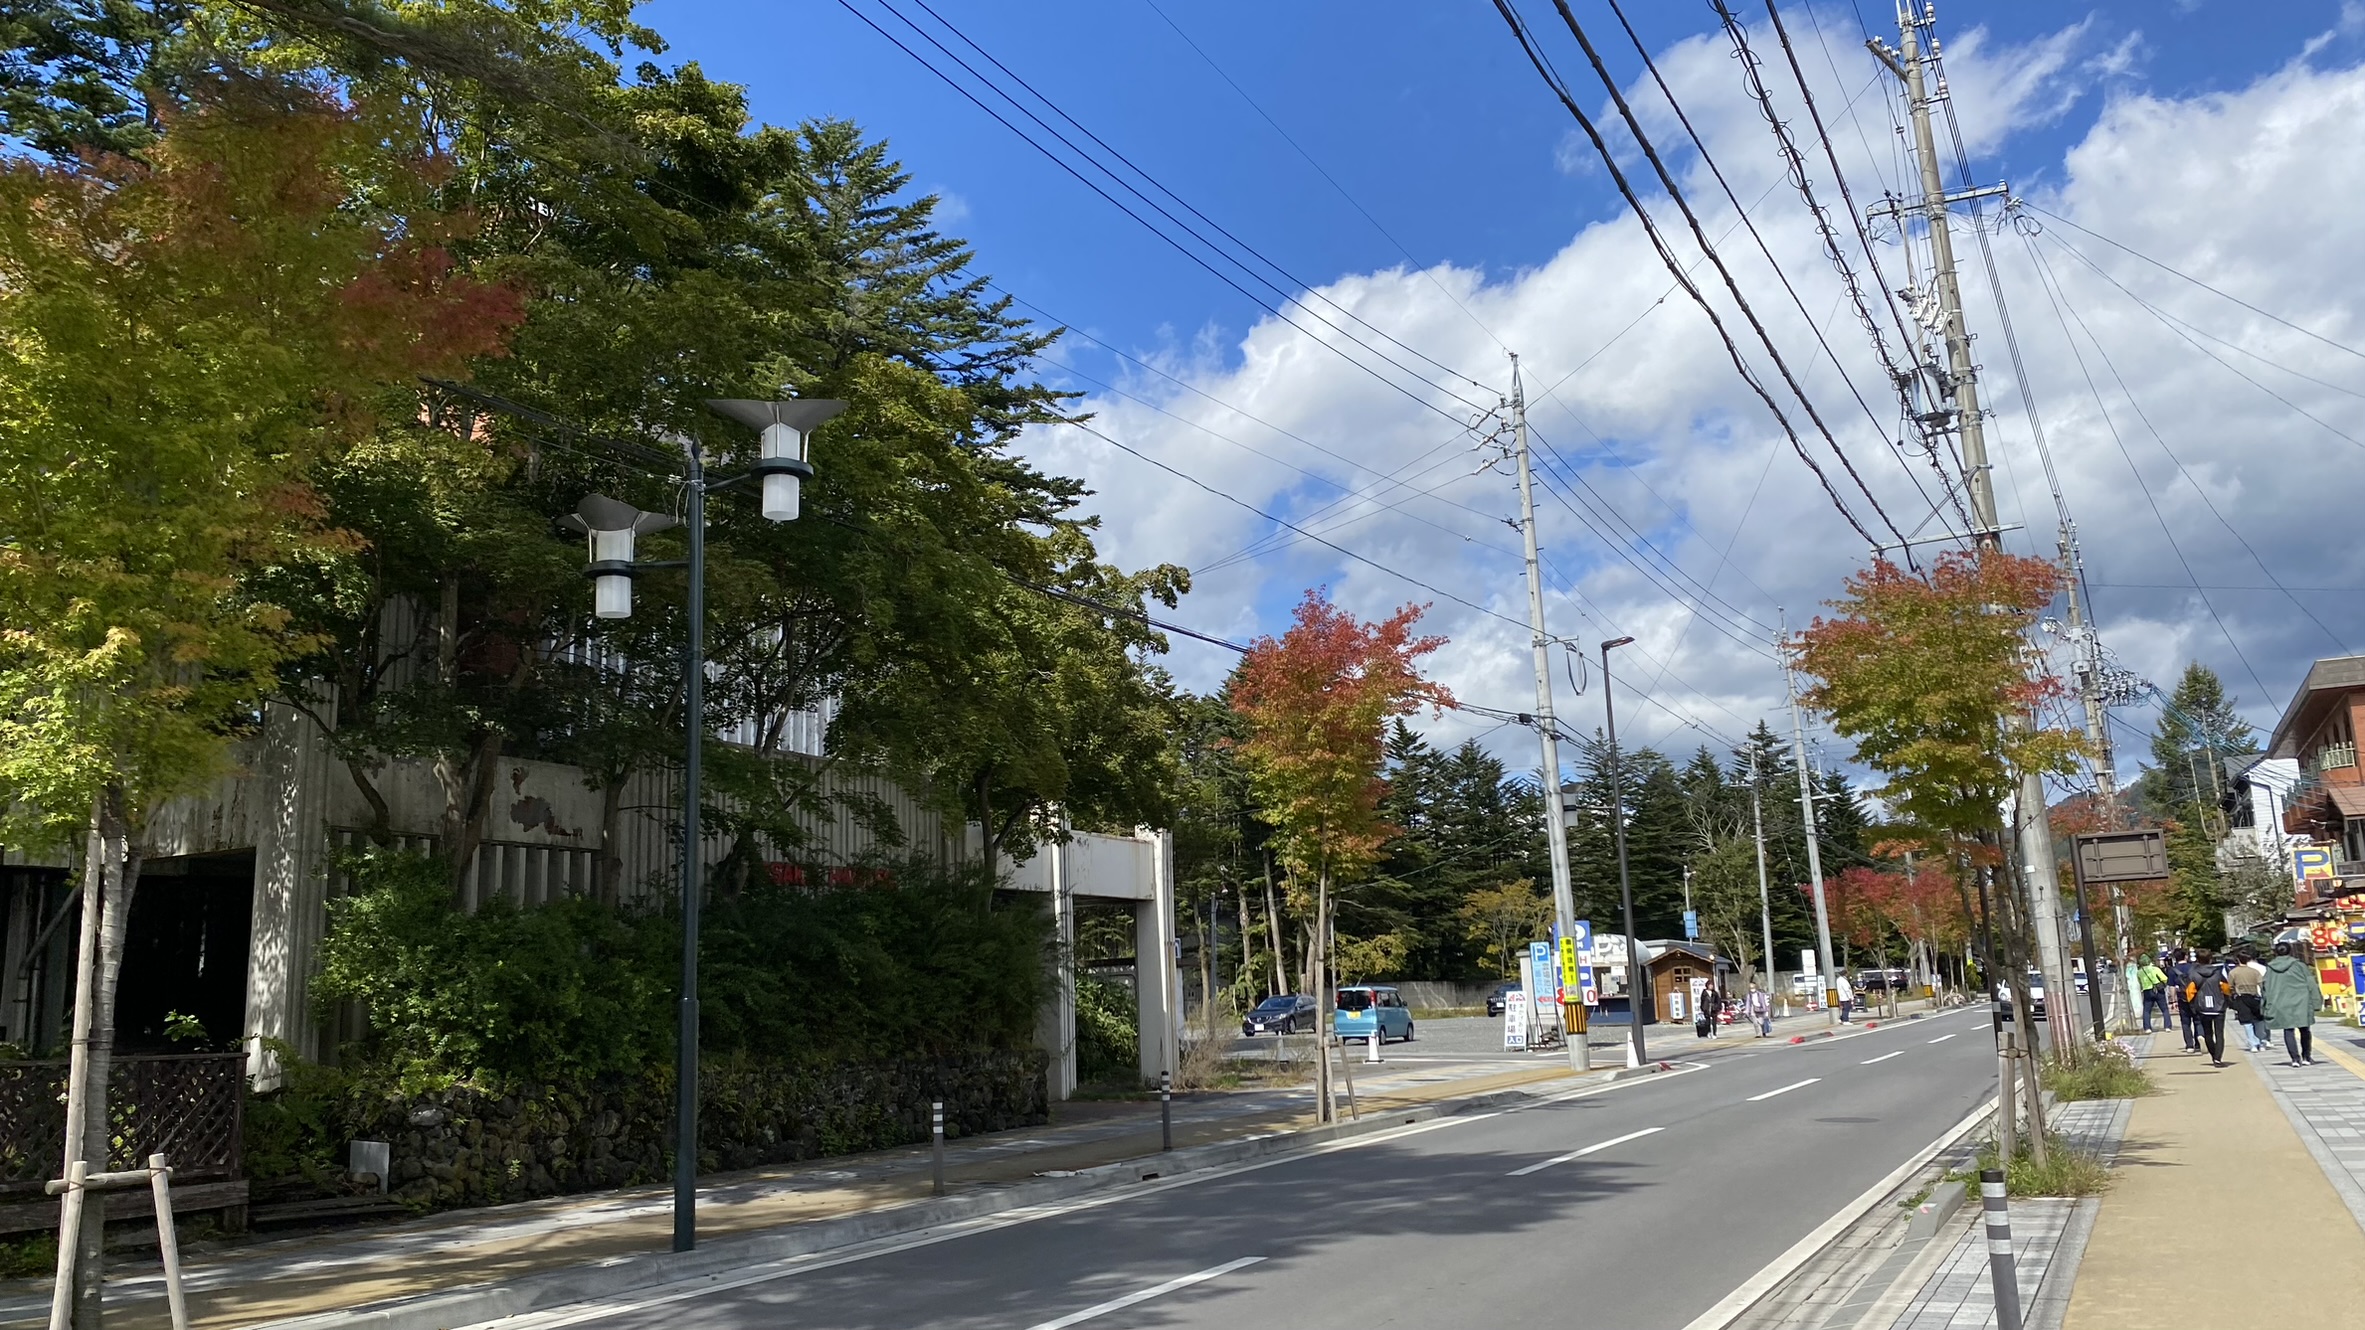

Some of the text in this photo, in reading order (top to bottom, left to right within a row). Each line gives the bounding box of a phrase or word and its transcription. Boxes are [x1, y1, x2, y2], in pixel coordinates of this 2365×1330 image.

[2294, 850, 2329, 880] P
[1534, 945, 1546, 961] P
[1507, 1003, 1516, 1034] 駐車場
[1508, 1036, 1523, 1044] 入口
